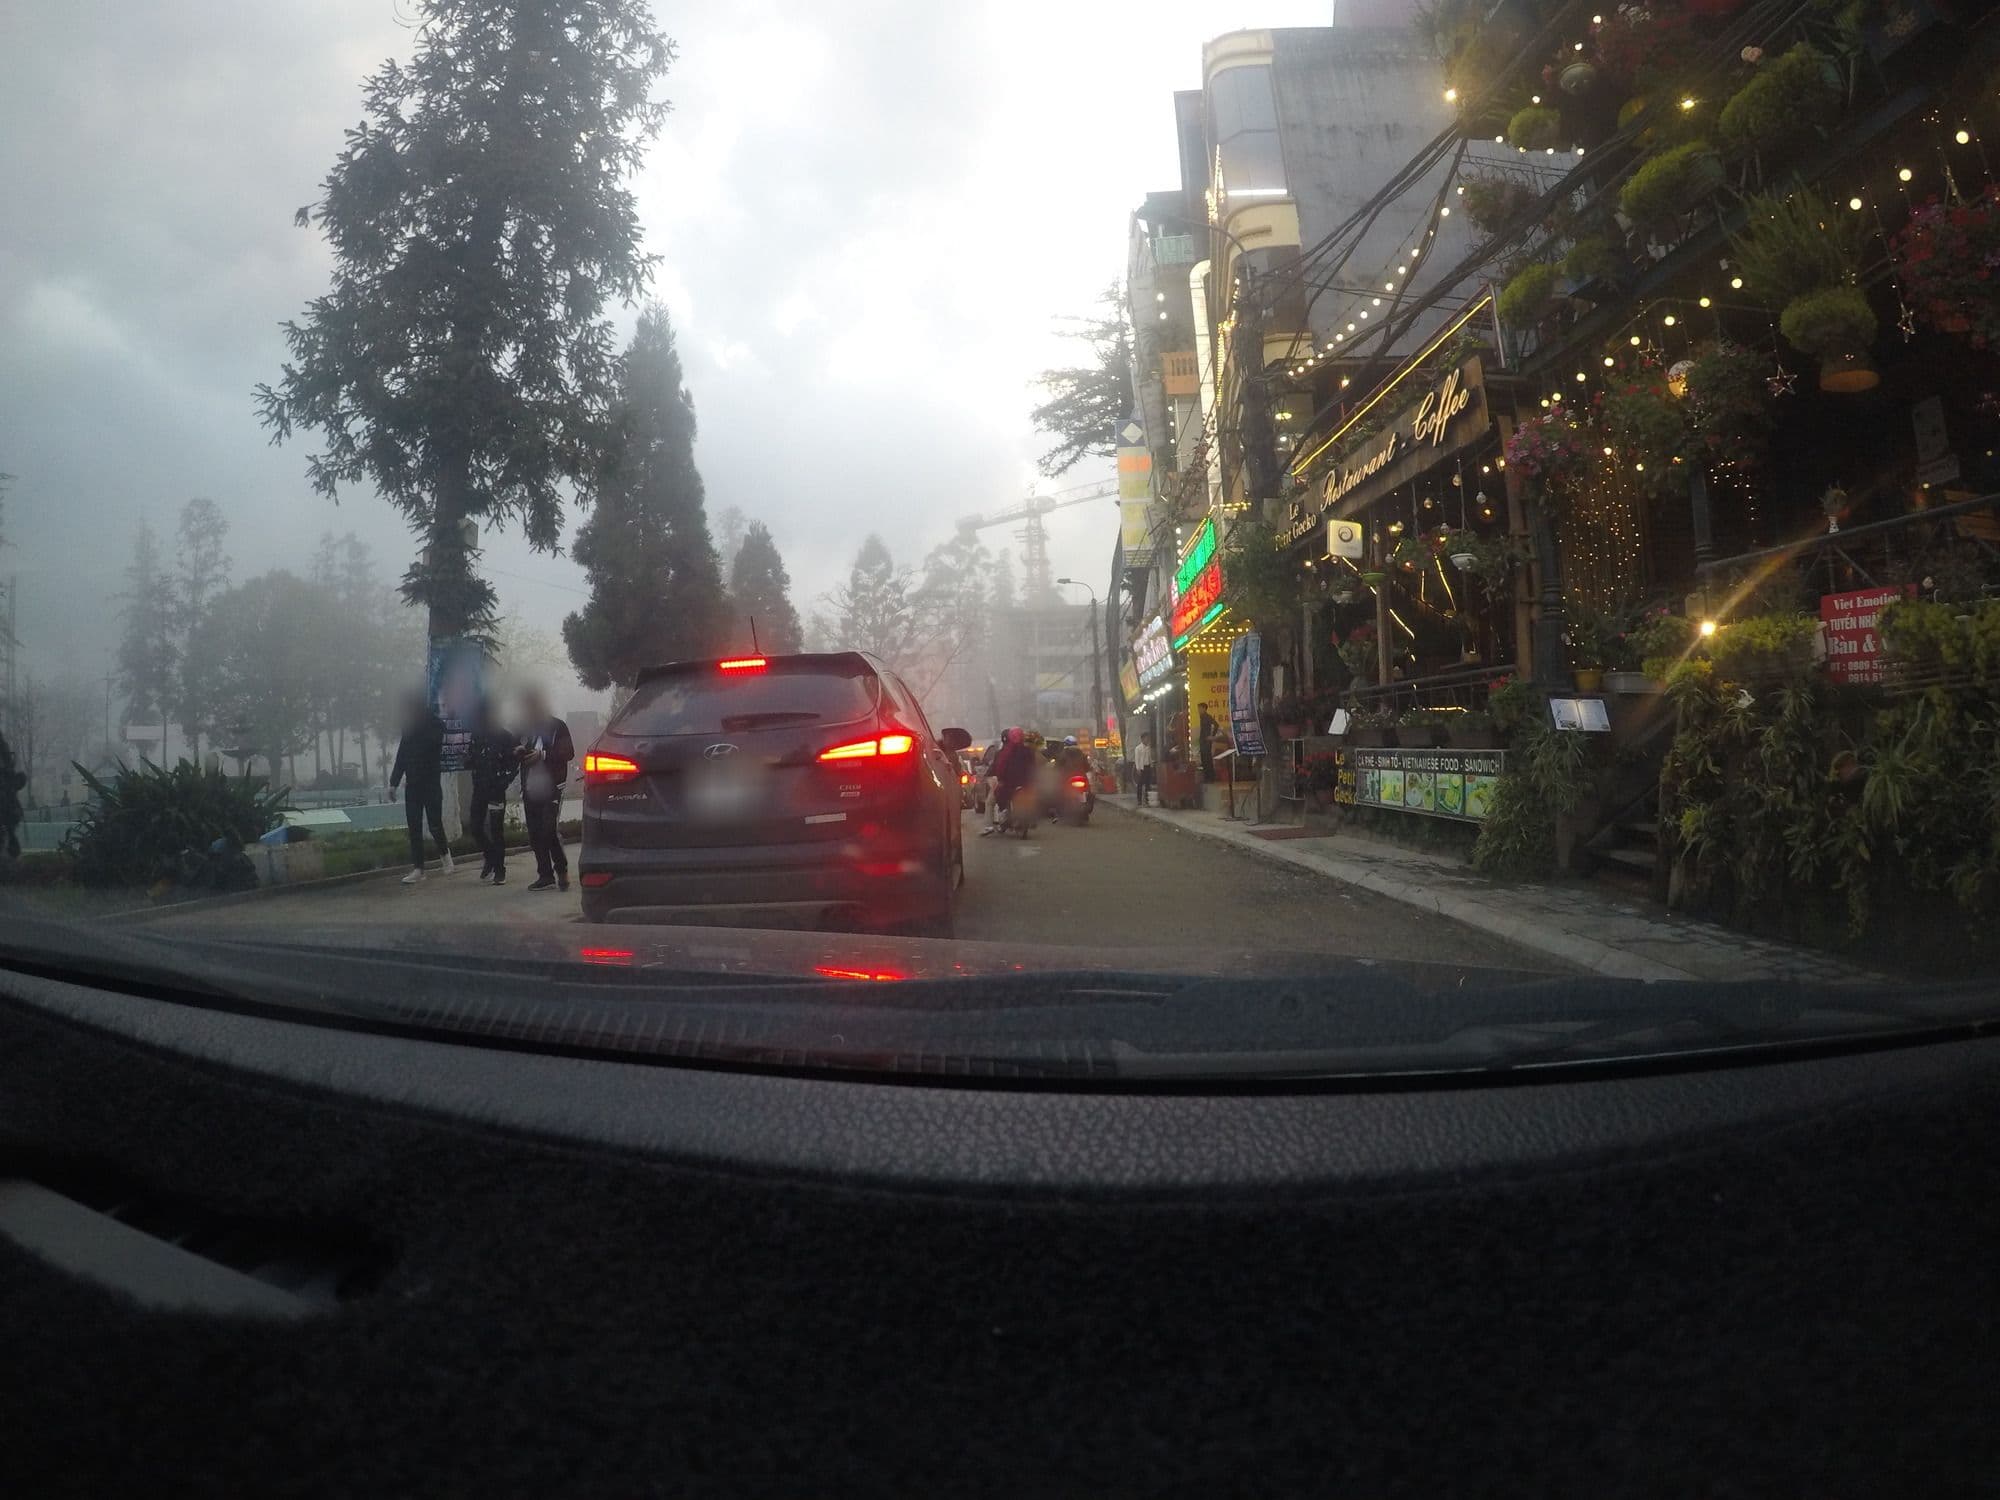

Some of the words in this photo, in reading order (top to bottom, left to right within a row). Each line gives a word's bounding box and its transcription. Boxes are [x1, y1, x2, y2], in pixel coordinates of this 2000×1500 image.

[1320, 432, 1397, 512] Restaurant
[1411, 368, 1470, 448] Coffee
[1289, 503, 1299, 521] Le
[1292, 513, 1317, 539] Gecko
[1862, 633, 1876, 653] &
[1402, 756, 1440, 770] VIETNAMESE
[1440, 758, 1459, 770] FOOD
[1465, 758, 1500, 773] SANDWICH
